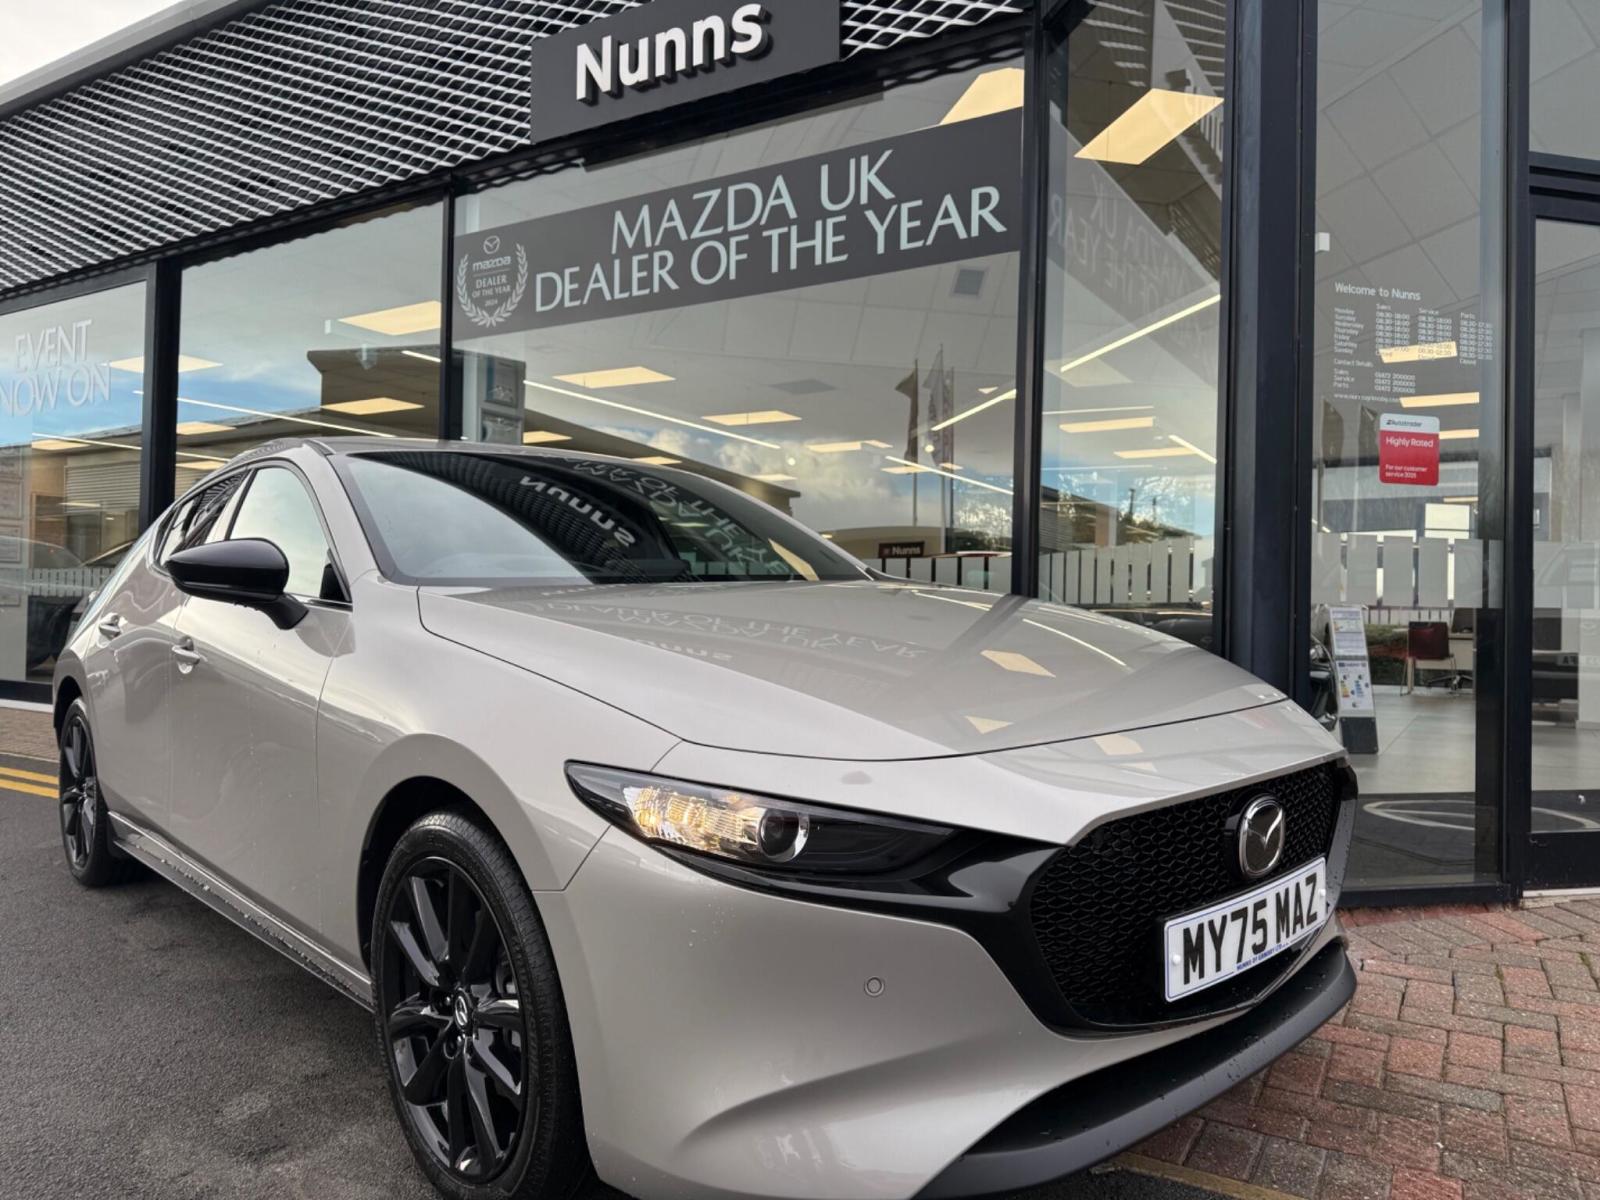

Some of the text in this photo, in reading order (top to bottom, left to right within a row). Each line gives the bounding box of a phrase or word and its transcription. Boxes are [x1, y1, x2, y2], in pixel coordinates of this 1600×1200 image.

[577, 3, 762, 100] Nunns
[611, 149, 896, 255] MAZDA UK
[535, 185, 1007, 313] DEALER OF THE YEAR
[471, 285, 511, 298] OF THE YEAR
[475, 275, 507, 288] DEALER
[1334, 282, 1421, 300] Welcome to Nunns
[15, 319, 92, 375] EVENT
[0, 360, 112, 417] NOW ON
[1385, 437, 1434, 447] Highly Rated
[1183, 872, 1317, 985] MY75 MAZ
